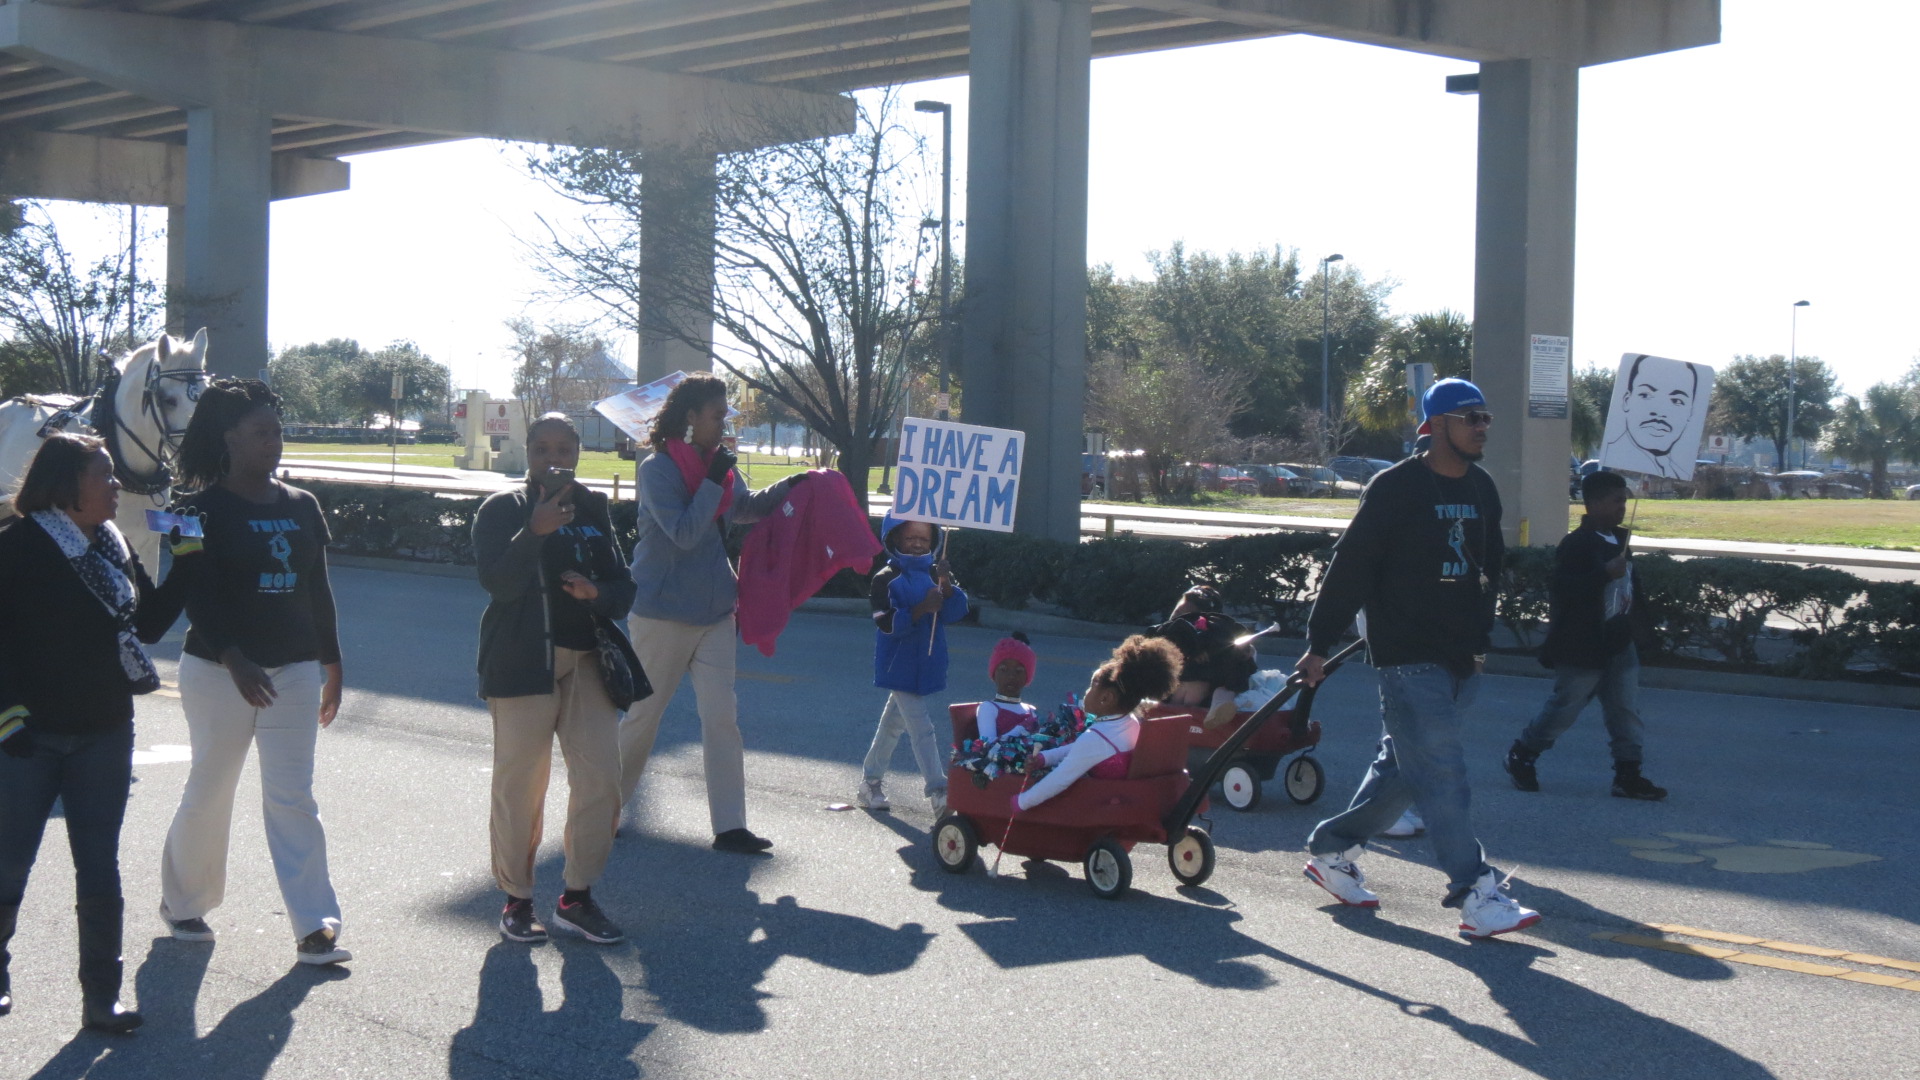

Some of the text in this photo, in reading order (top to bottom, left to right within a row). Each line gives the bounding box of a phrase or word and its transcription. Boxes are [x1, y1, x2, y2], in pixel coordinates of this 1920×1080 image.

[900, 424, 1018, 476] I HAVE A
[895, 466, 1016, 527] DREAM
[1434, 504, 1479, 519] TWIRL
[248, 519, 301, 533] TWIRL
[1442, 561, 1469, 576] DAD
[259, 572, 298, 588] MOM
